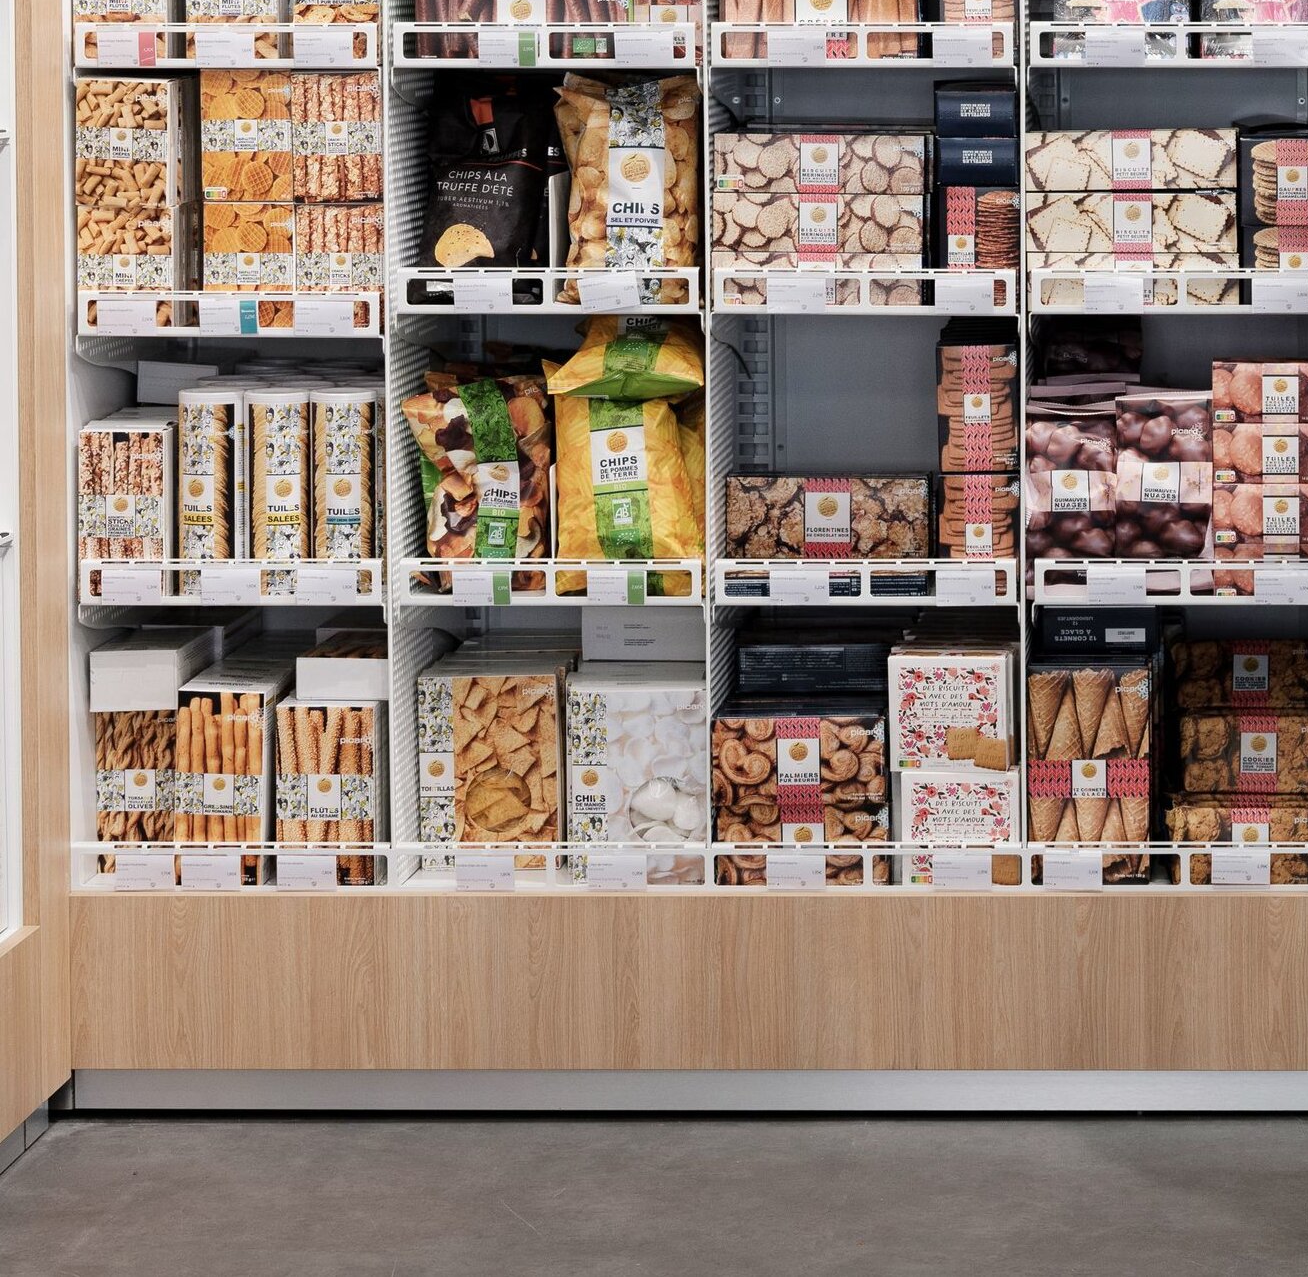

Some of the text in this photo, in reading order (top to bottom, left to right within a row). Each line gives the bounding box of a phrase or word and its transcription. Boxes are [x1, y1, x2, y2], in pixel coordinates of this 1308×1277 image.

[448, 169, 507, 182] CHIPS À LA
[437, 181, 514, 197] TRUFFE D'ÉTÉ
[634, 217, 658, 225] POIVRE
[600, 455, 638, 468] CHIPS
[611, 465, 638, 474] POMMES
[613, 471, 638, 479] TERRE
[484, 488, 518, 500] CHIPS
[327, 507, 360, 515] TUILES
[184, 514, 212, 522] SALÉES
[267, 514, 300, 523] SALÉES
[575, 794, 606, 803] CHIPS
